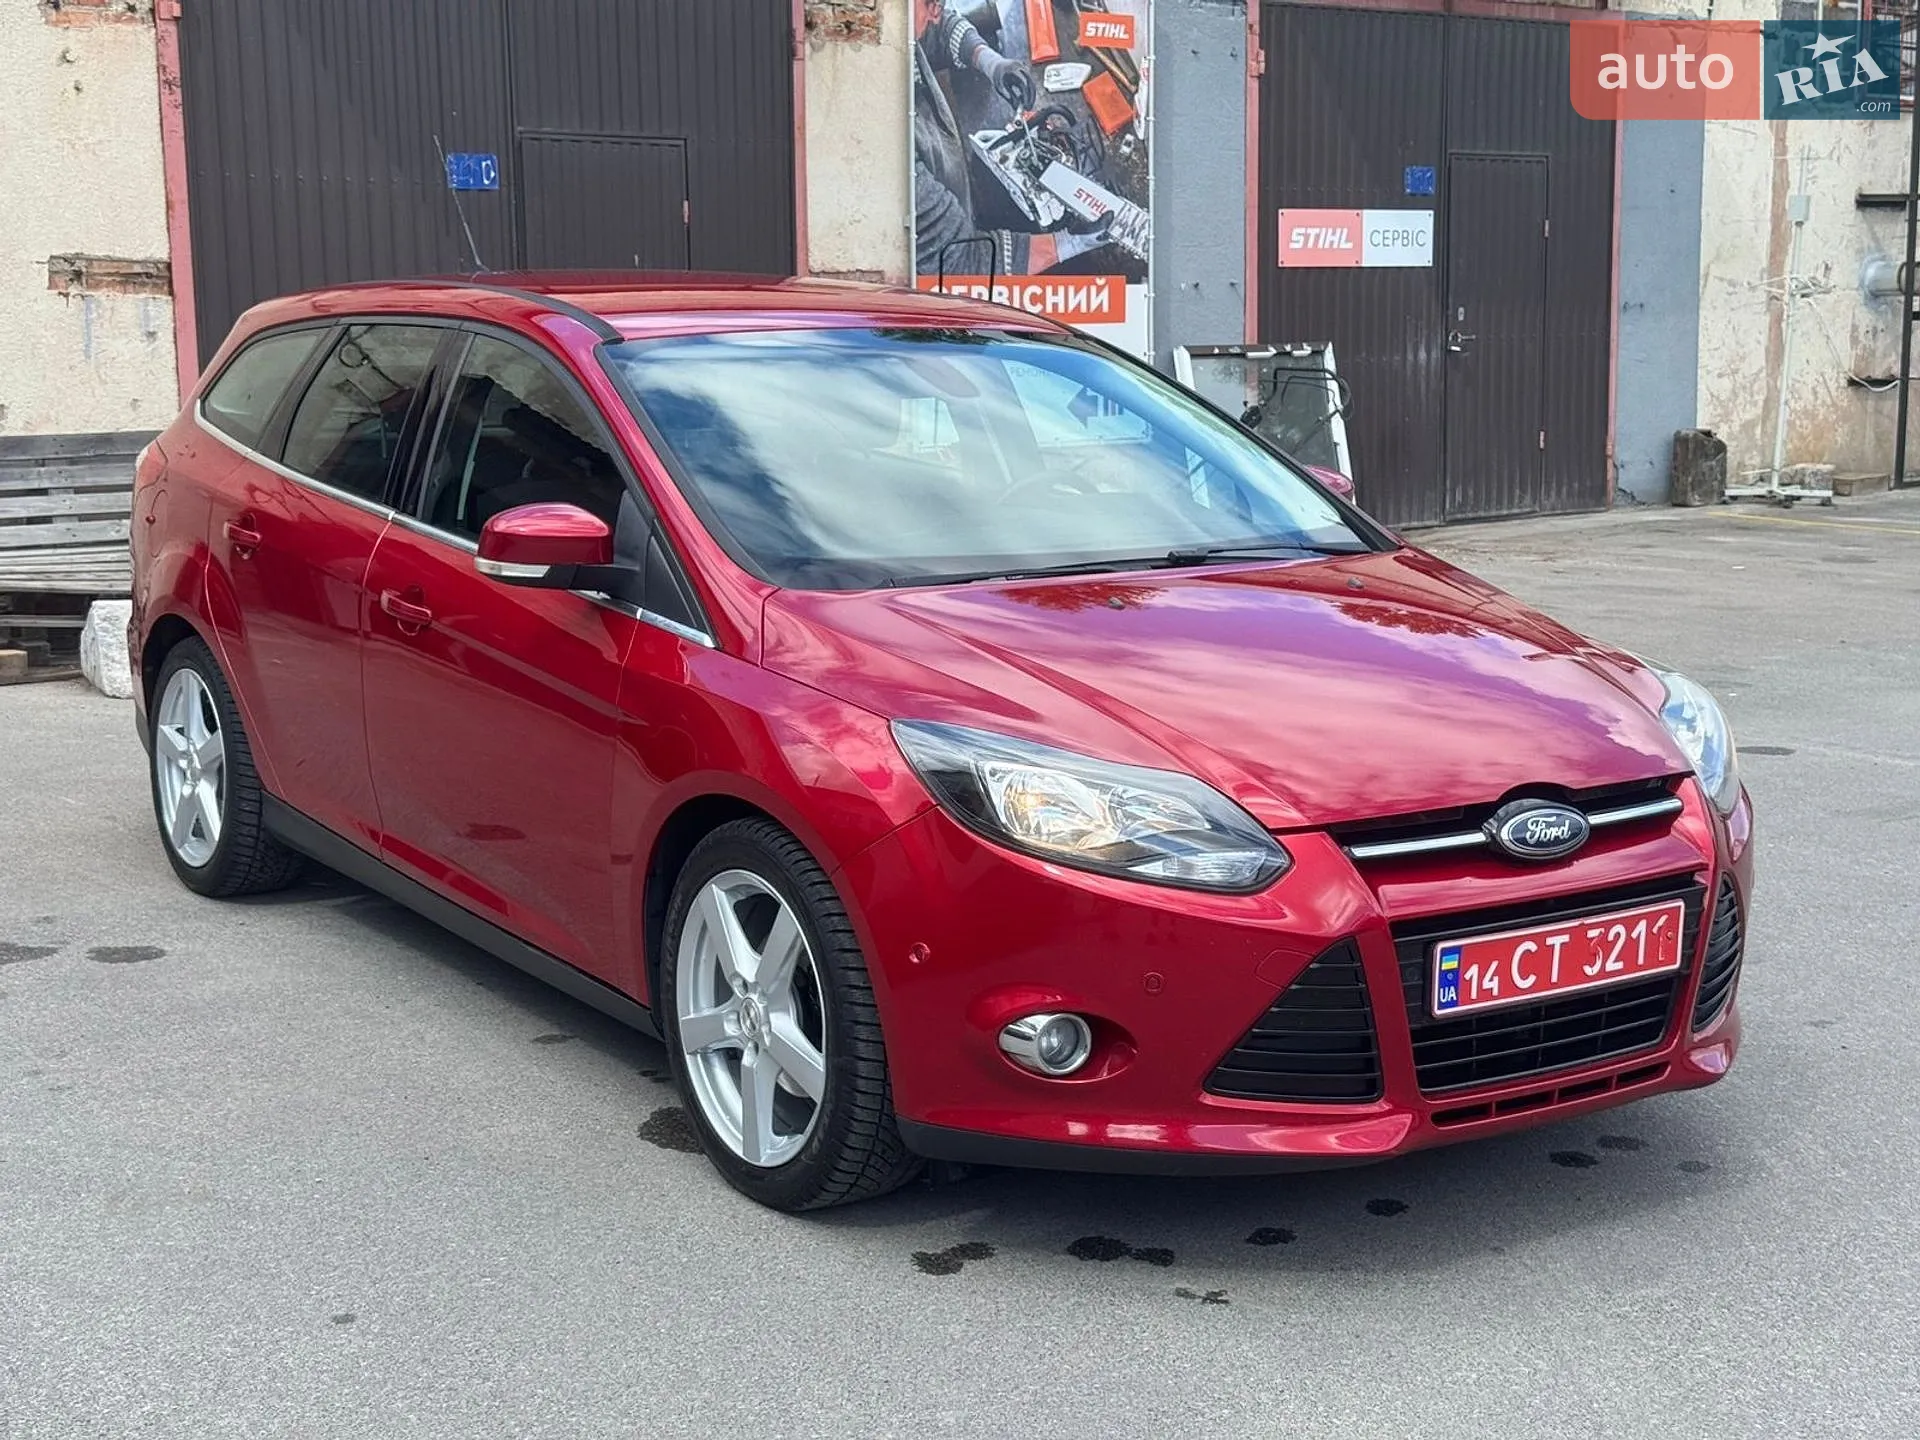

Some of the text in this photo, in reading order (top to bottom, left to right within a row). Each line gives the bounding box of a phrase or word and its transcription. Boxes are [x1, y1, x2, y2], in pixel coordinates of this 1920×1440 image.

[1085, 21, 1130, 40] STIHL
[1289, 227, 1427, 249] STIHL СЕРВІС
[929, 278, 1109, 314] РВІСНИЙ
[1525, 816, 1571, 844] Ford
[1463, 960, 1499, 1000] 14
[1511, 934, 1570, 989] CT
[1440, 986, 1456, 1003] UA
